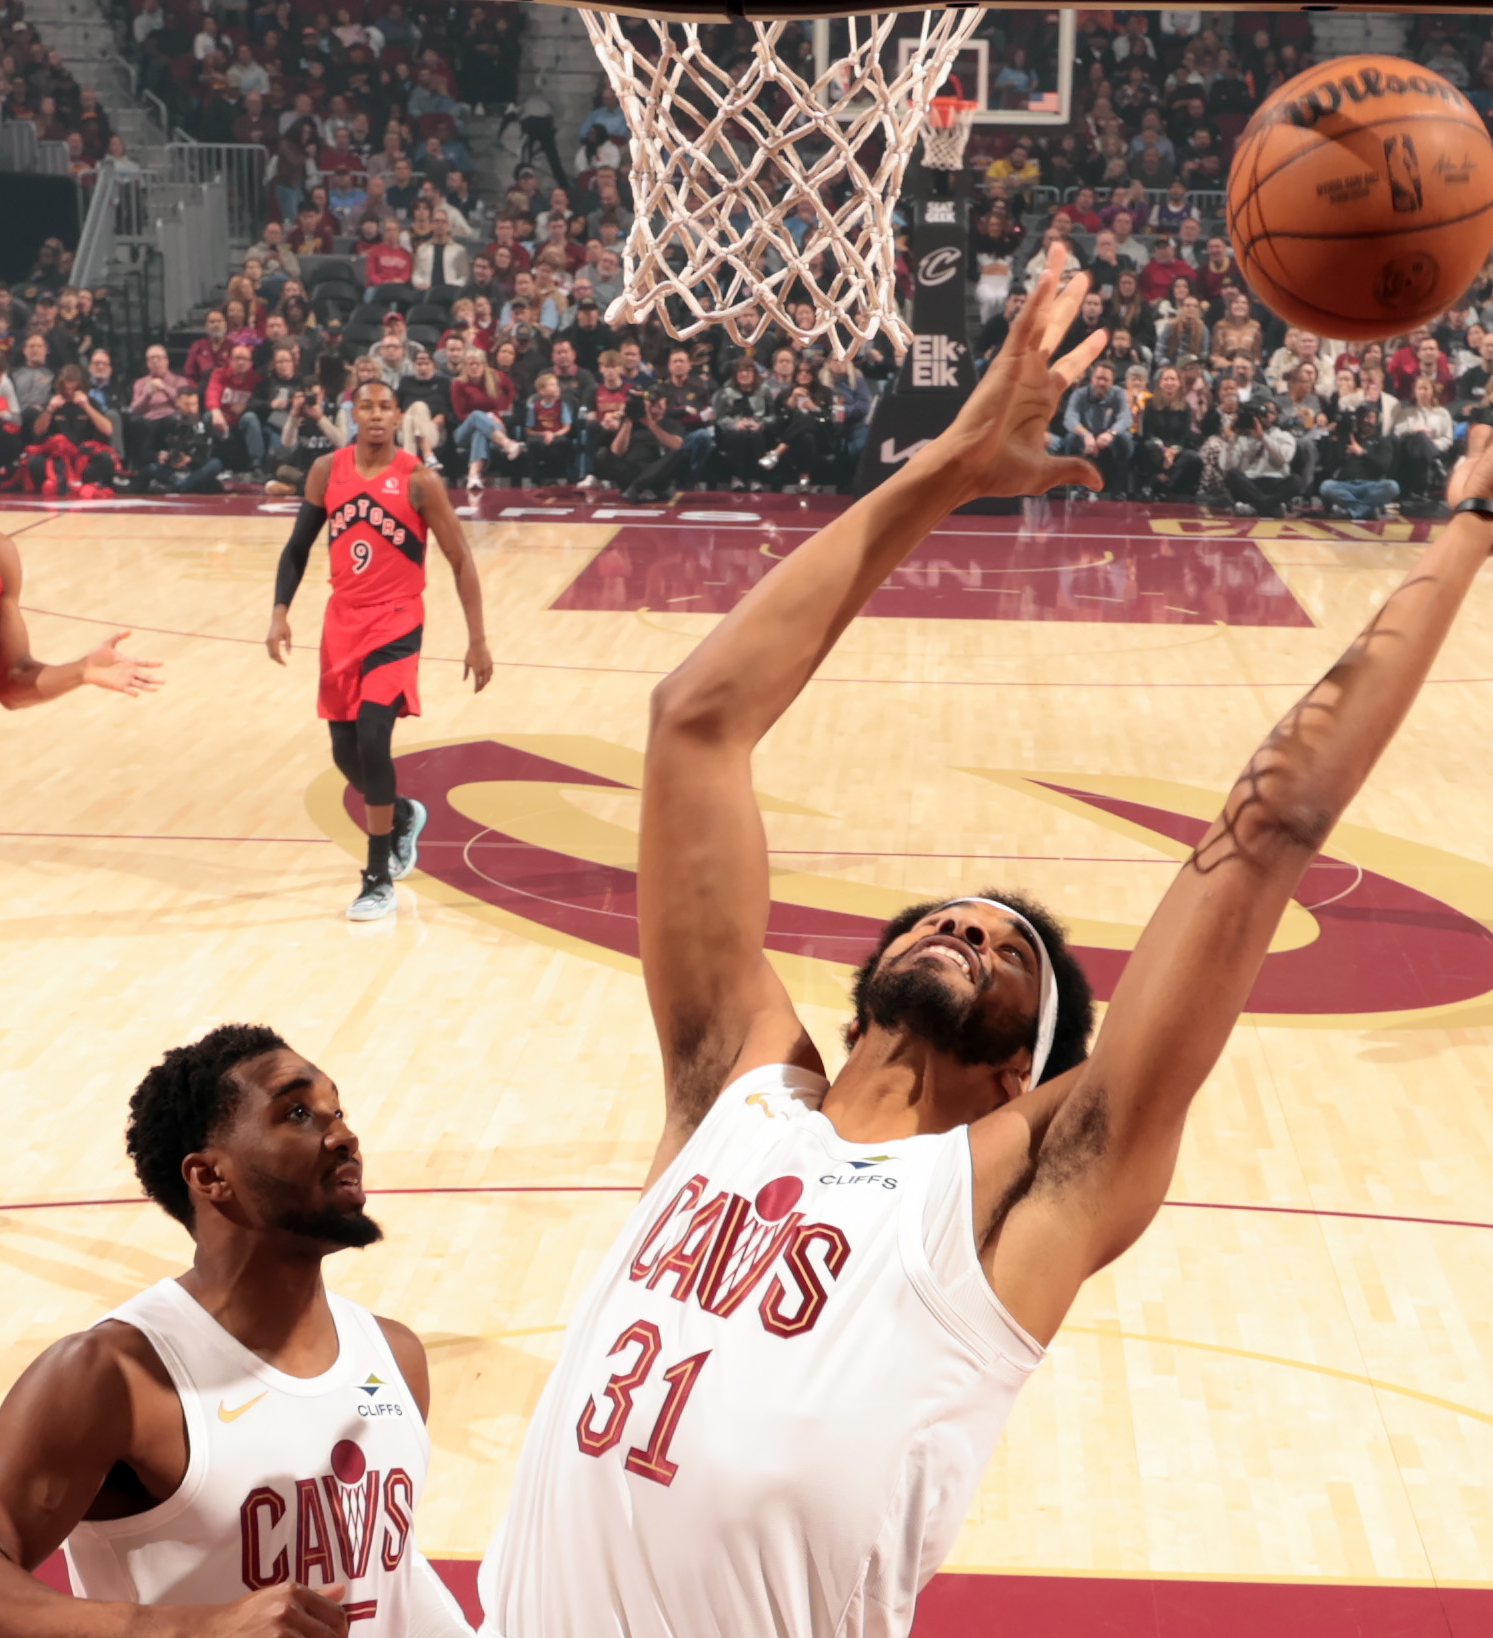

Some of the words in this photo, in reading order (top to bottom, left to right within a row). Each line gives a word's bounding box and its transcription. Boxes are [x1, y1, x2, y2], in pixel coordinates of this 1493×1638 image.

[912, 361, 960, 387] Elk
[350, 539, 372, 574] 9
[819, 1174, 899, 1192] CLIFFS
[629, 1174, 851, 1340] CAVS
[357, 1403, 403, 1418] CLIFFS
[576, 1319, 713, 1487] 31
[240, 1467, 413, 1593] CAVS
